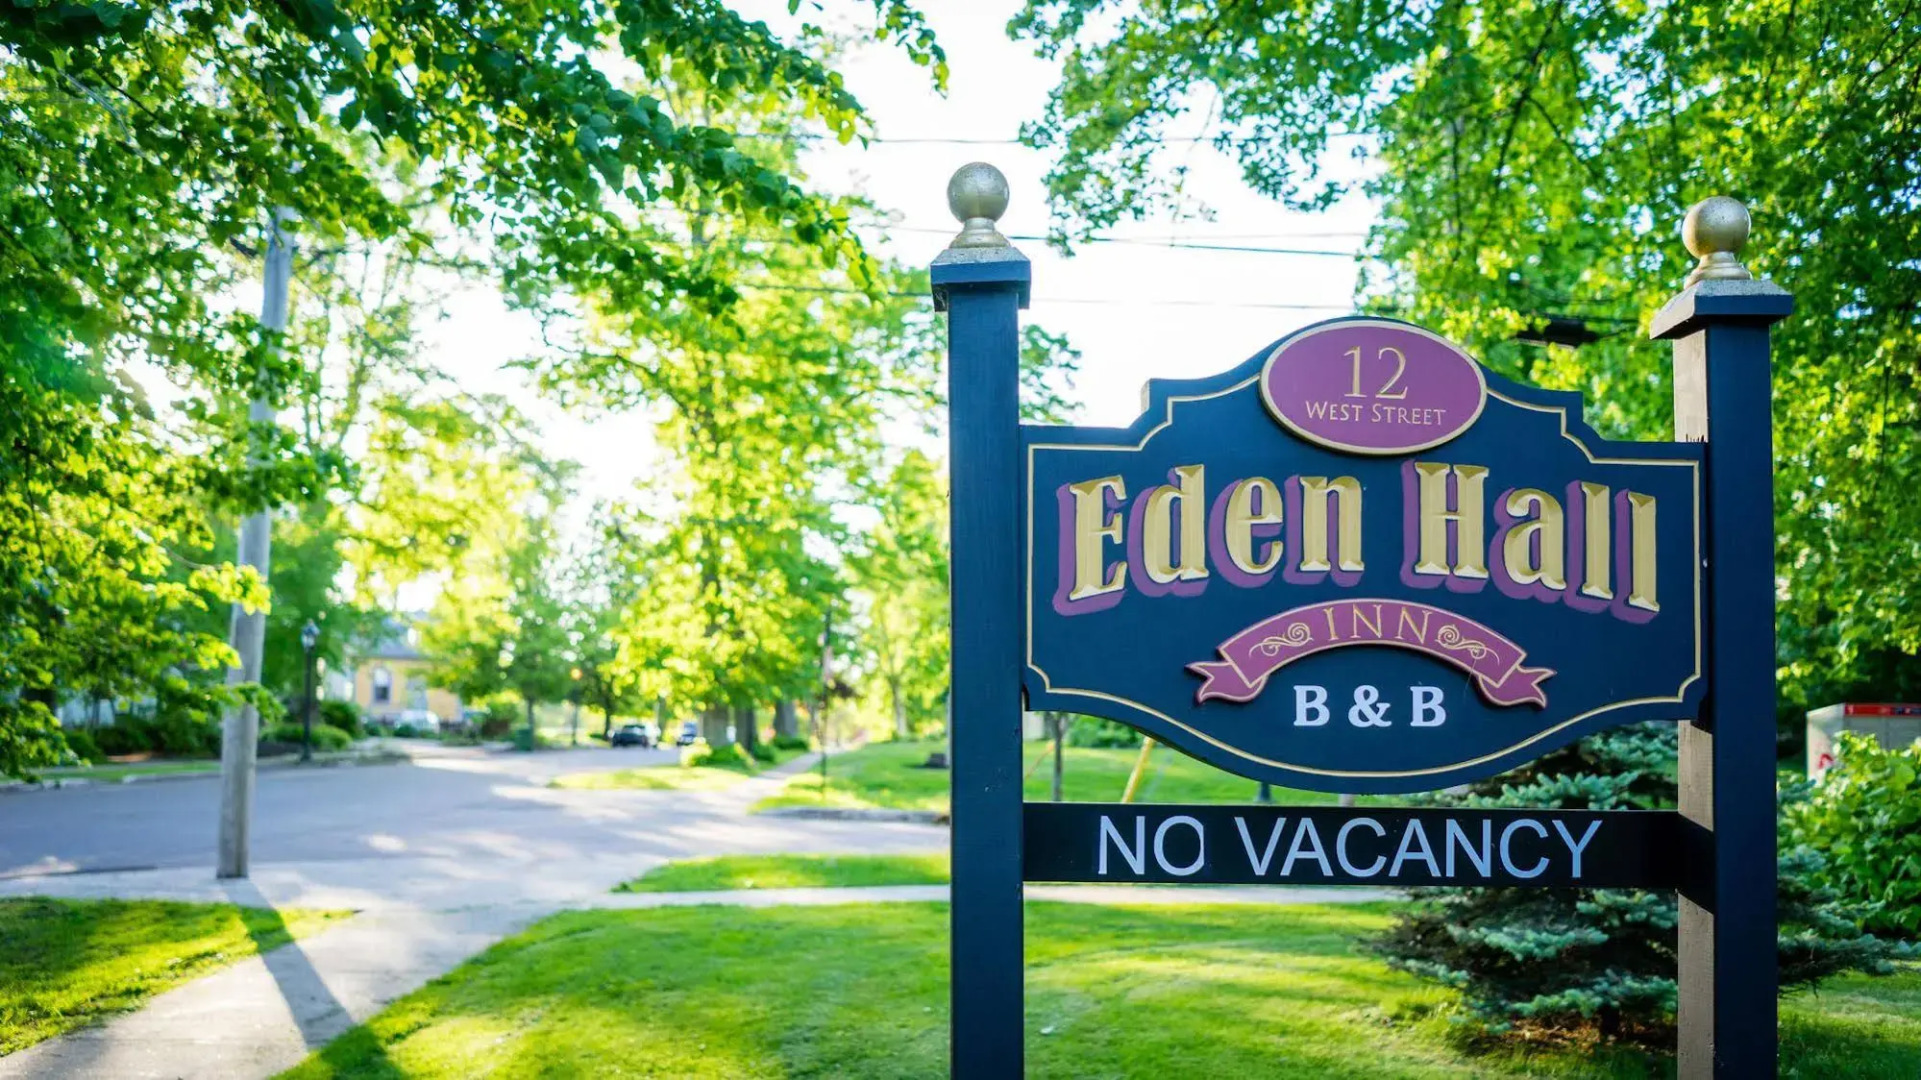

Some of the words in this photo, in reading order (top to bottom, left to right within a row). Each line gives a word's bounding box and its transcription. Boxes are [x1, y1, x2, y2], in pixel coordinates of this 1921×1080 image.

[1343, 346, 1408, 400] 12
[1305, 401, 1363, 422] WEST
[1372, 403, 1446, 426] STREET
[1064, 464, 1365, 604] Eden
[1410, 461, 1660, 613] Hall
[1326, 604, 1431, 642] INN
[1293, 685, 1330, 727] B
[1347, 685, 1392, 727] &
[1409, 686, 1447, 728] B
[1098, 815, 1205, 876] NO
[1234, 816, 1603, 878] VACANCY
